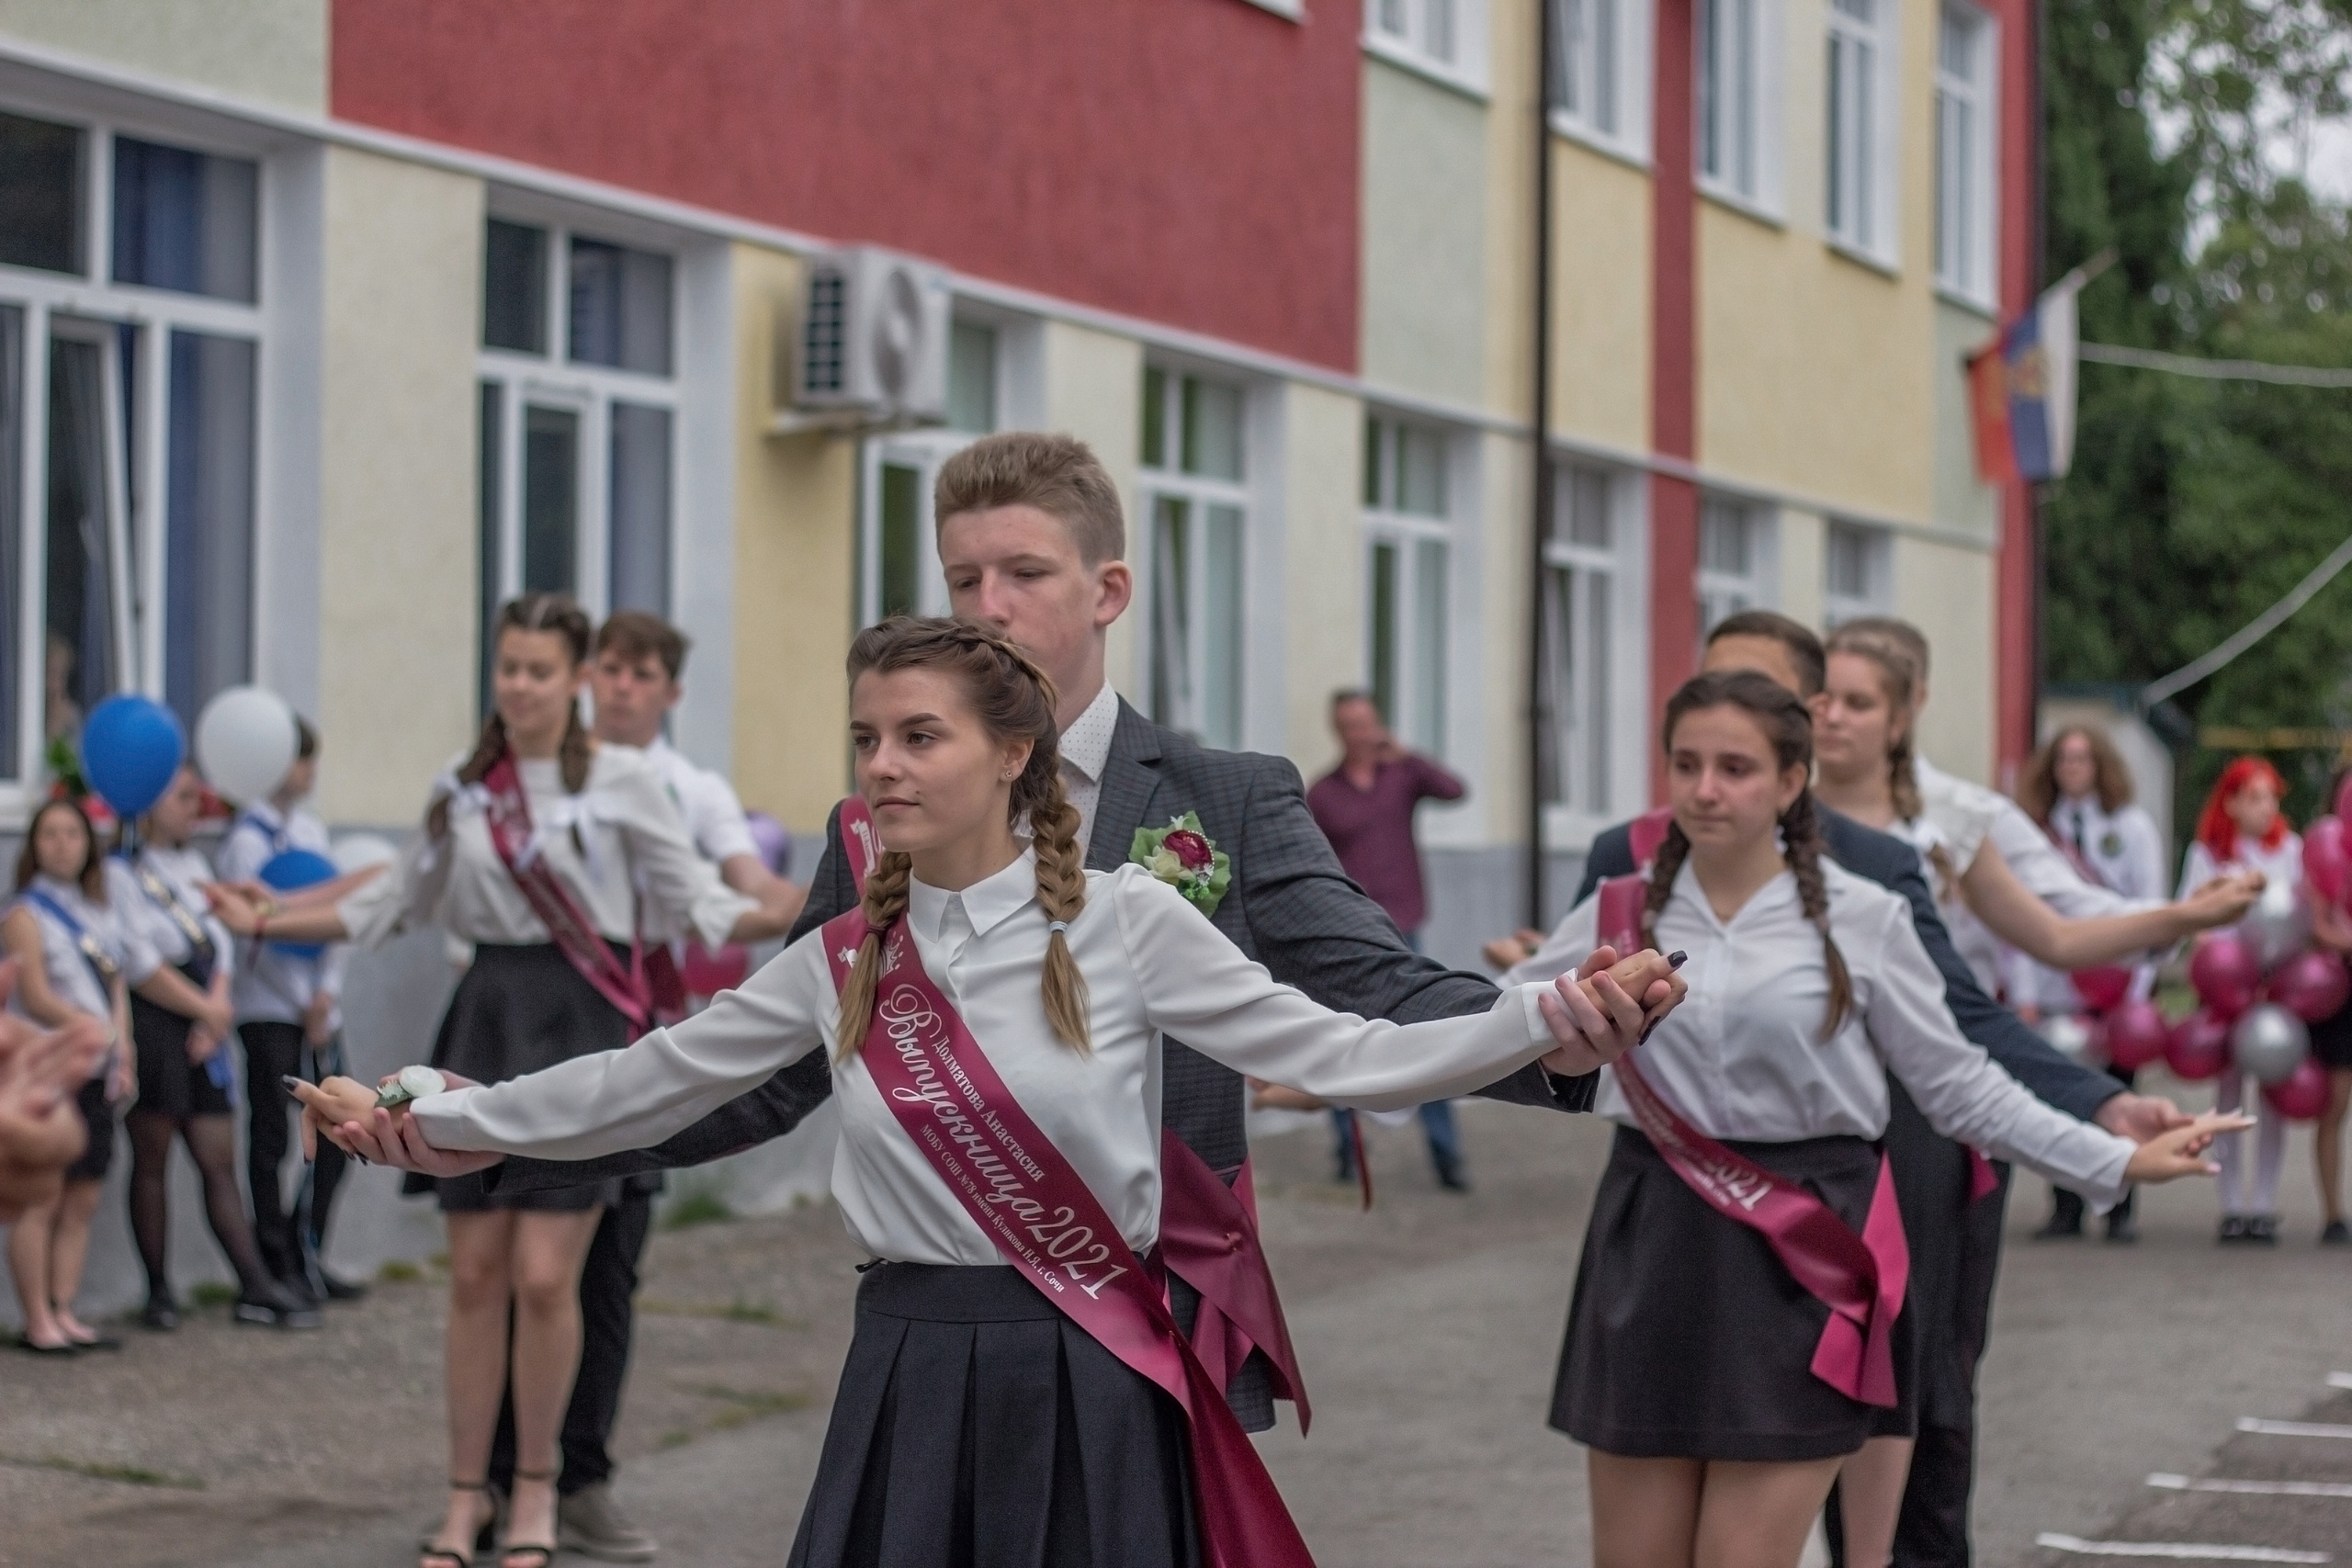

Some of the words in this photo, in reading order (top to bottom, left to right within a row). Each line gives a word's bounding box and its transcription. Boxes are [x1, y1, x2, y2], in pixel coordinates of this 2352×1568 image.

[878, 983, 1046, 1222] Выпускница
[1024, 1205, 1129, 1300] 2021
[931, 1034, 986, 1112] Долматова
[979, 1109, 1046, 1183] Анастасия
[920, 1123, 946, 1152] МОБУ
[940, 1150, 964, 1177] СОШ
[956, 1173, 978, 1195] №78
[971, 1192, 996, 1219] имени
[991, 1213, 1026, 1253] Куликова
[1022, 1247, 1041, 1269] Н.Я.
[1044, 1270, 1066, 1293] Сочи
